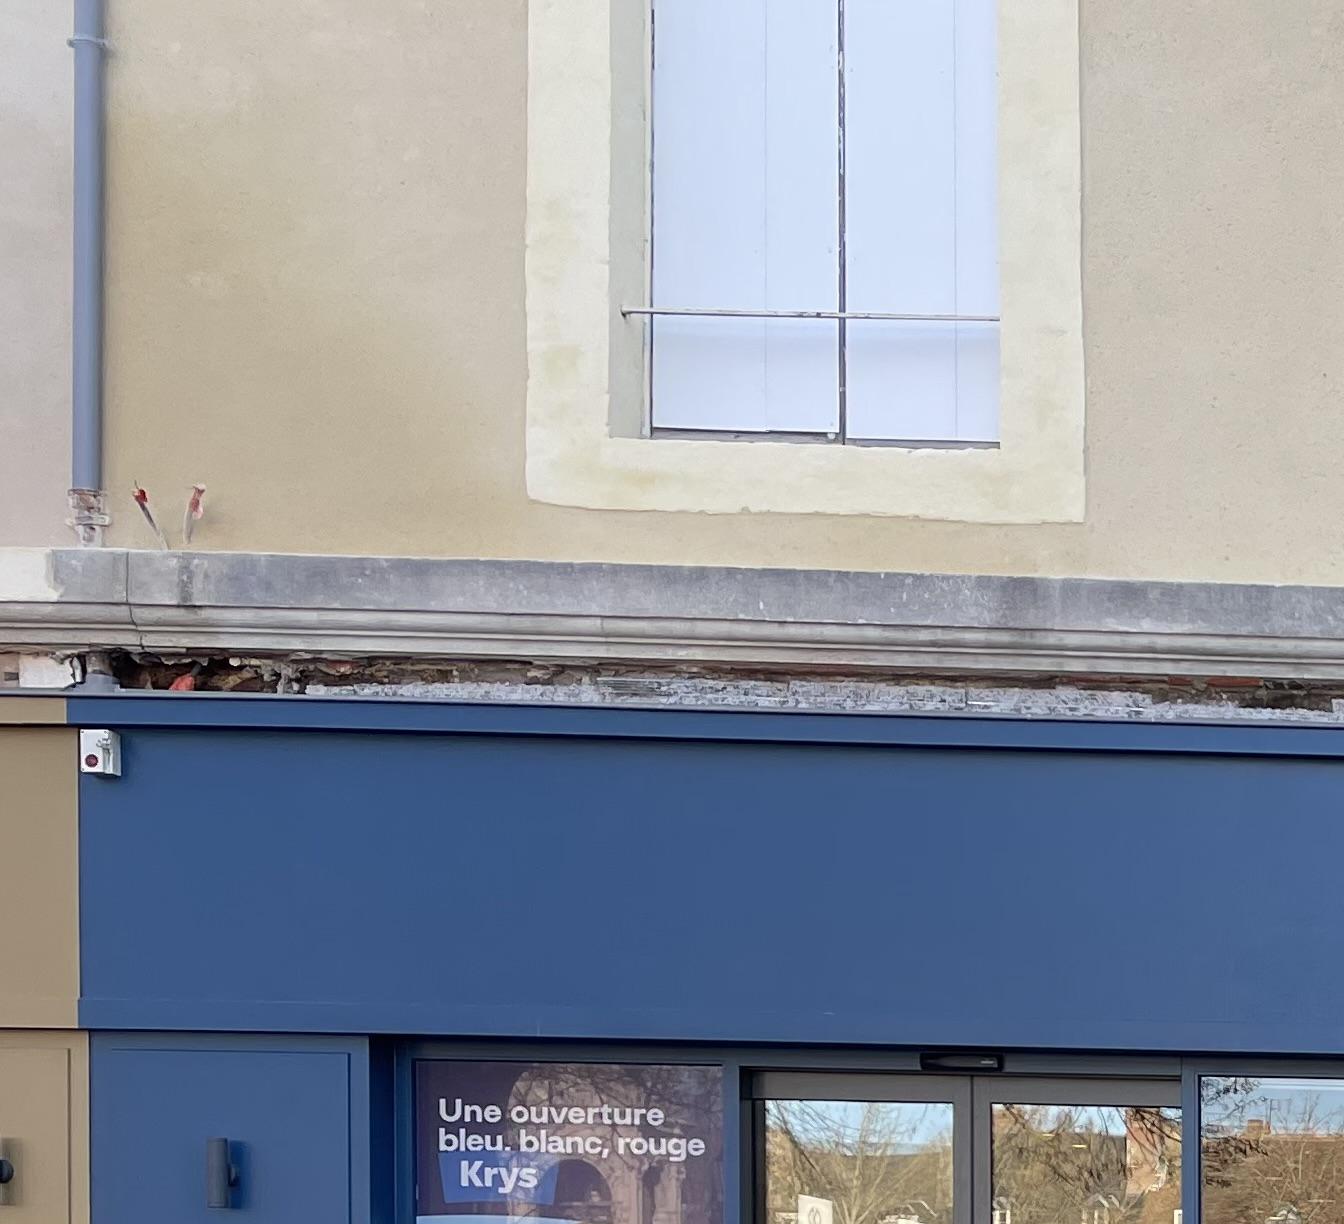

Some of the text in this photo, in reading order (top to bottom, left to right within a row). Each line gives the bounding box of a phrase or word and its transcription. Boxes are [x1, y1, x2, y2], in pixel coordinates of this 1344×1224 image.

[438, 1098, 665, 1126] Une ouverture
[519, 1129, 609, 1159] blanc,
[617, 1136, 706, 1162] rouge
[460, 1160, 539, 1194] Krys
